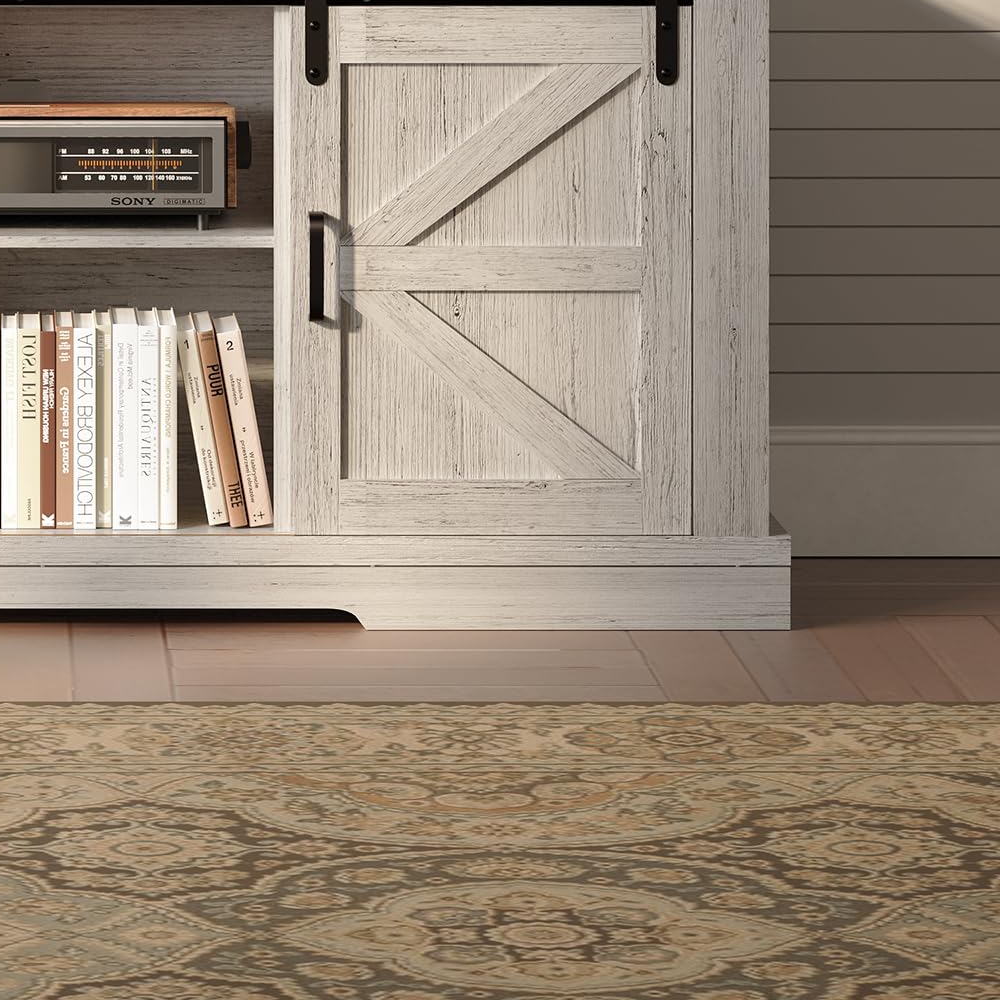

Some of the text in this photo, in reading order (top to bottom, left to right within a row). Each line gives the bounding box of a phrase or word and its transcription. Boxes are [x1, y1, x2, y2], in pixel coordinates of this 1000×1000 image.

[111, 197, 156, 206] SONY
[184, 339, 189, 350] 1
[226, 340, 234, 351] 2
[206, 363, 243, 508] PUUR THEE
